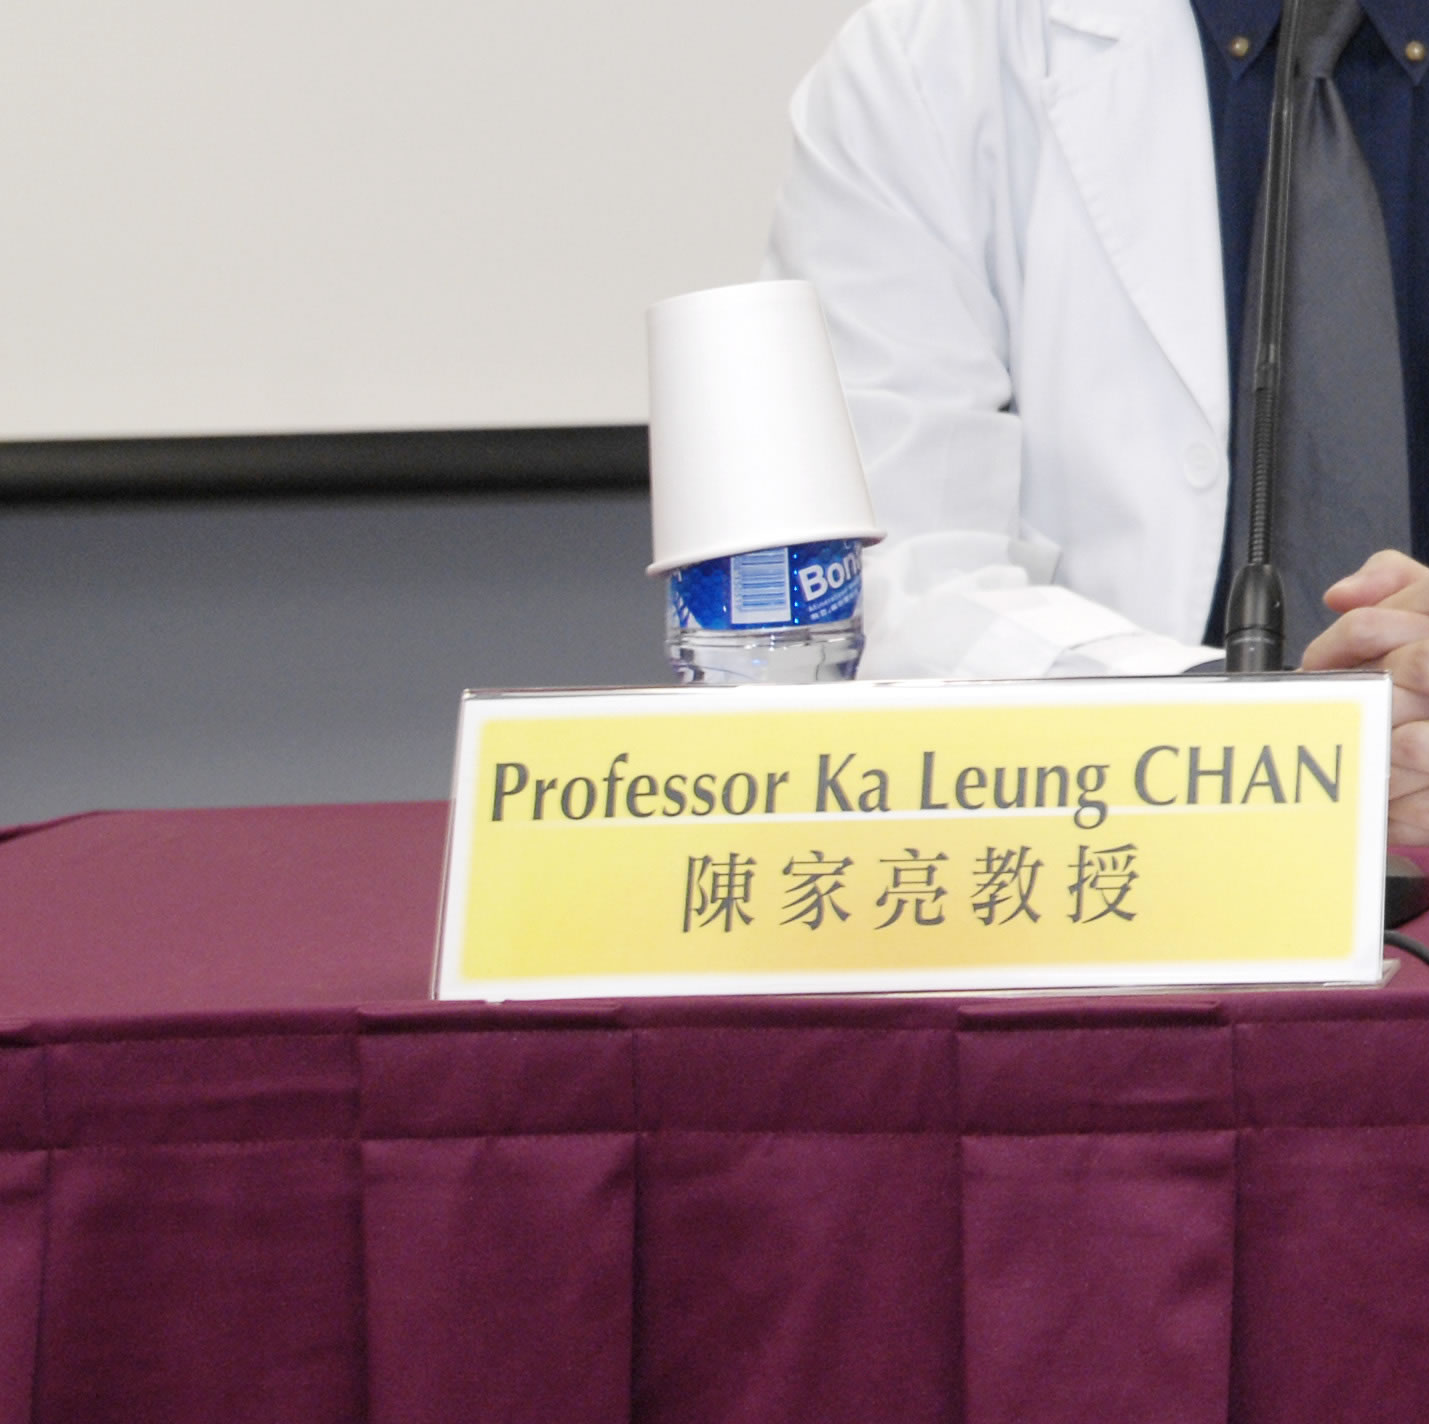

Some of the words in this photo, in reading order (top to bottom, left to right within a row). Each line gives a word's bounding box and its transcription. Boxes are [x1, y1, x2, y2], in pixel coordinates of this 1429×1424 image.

[490, 752, 789, 822] Professor
[814, 753, 892, 813] Ka
[919, 750, 1111, 830] Leung
[1133, 743, 1343, 806] CHAN
[682, 842, 1140, 934] 陳家亮教授
